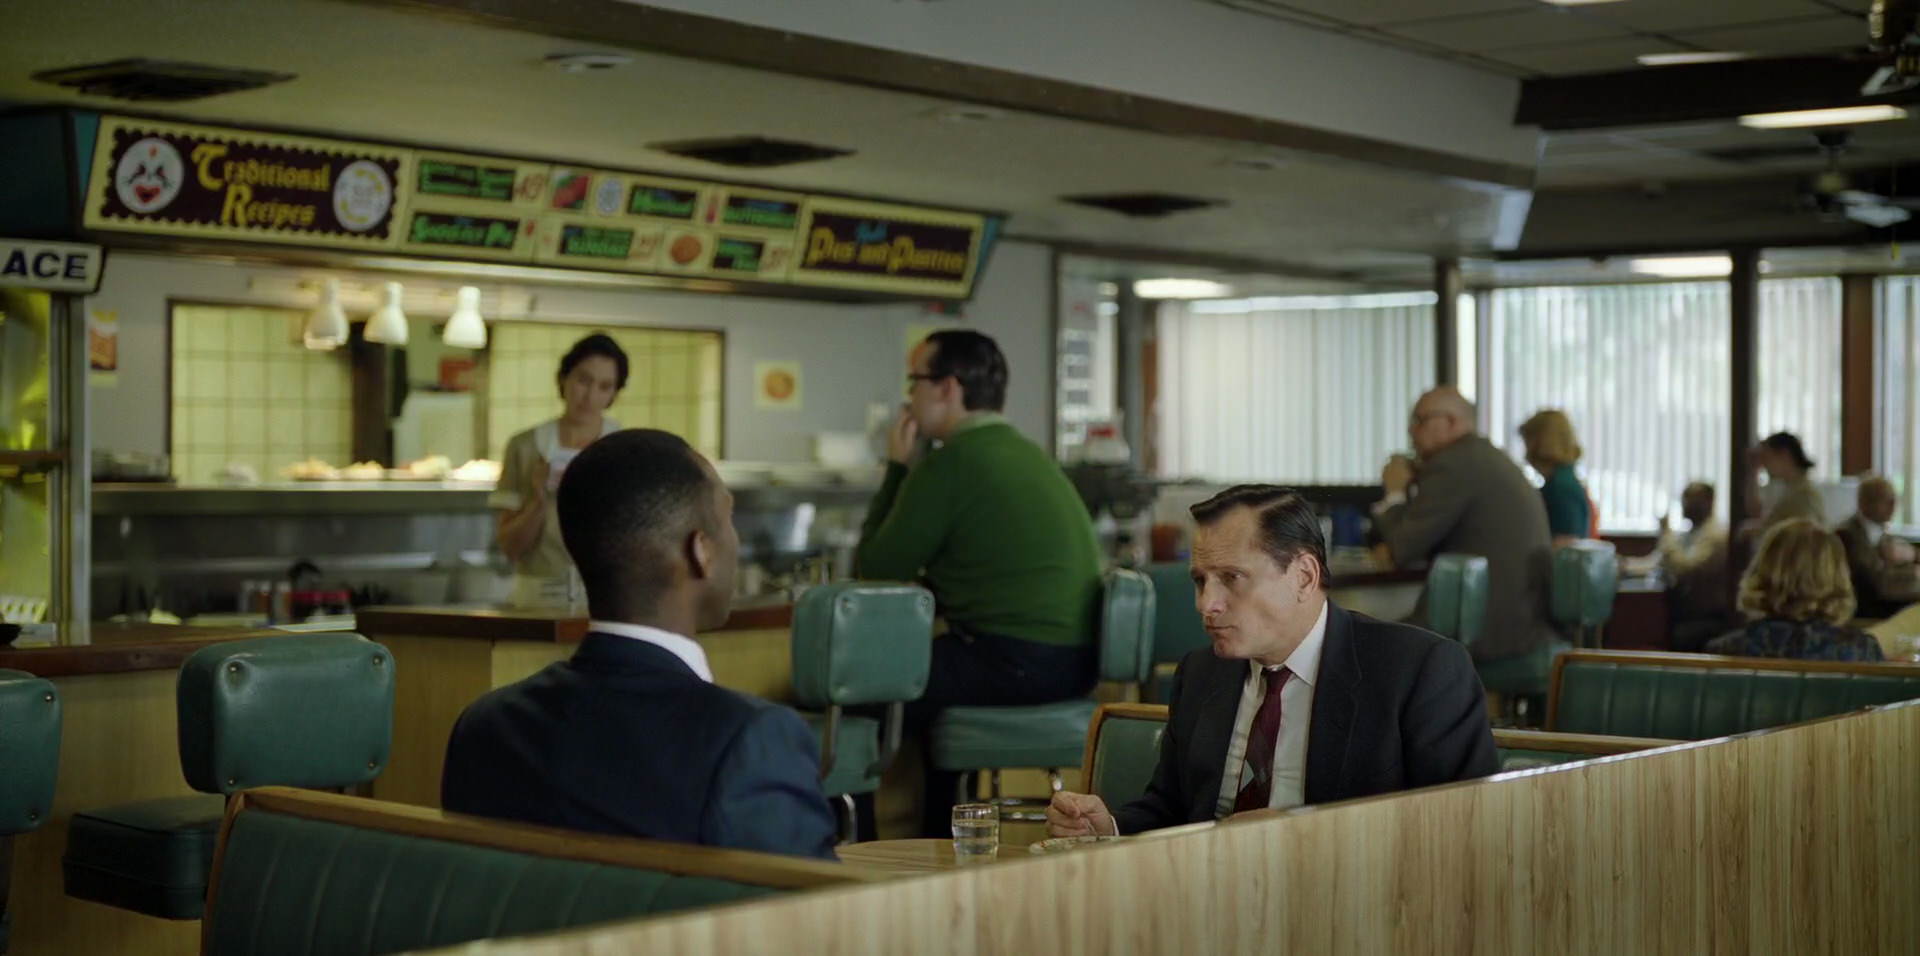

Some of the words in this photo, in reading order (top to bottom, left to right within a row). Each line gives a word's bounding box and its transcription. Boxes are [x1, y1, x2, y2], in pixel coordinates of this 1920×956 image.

[192, 142, 330, 191] Traditional
[220, 184, 317, 227] Recipes
[2, 249, 89, 280] ACE
